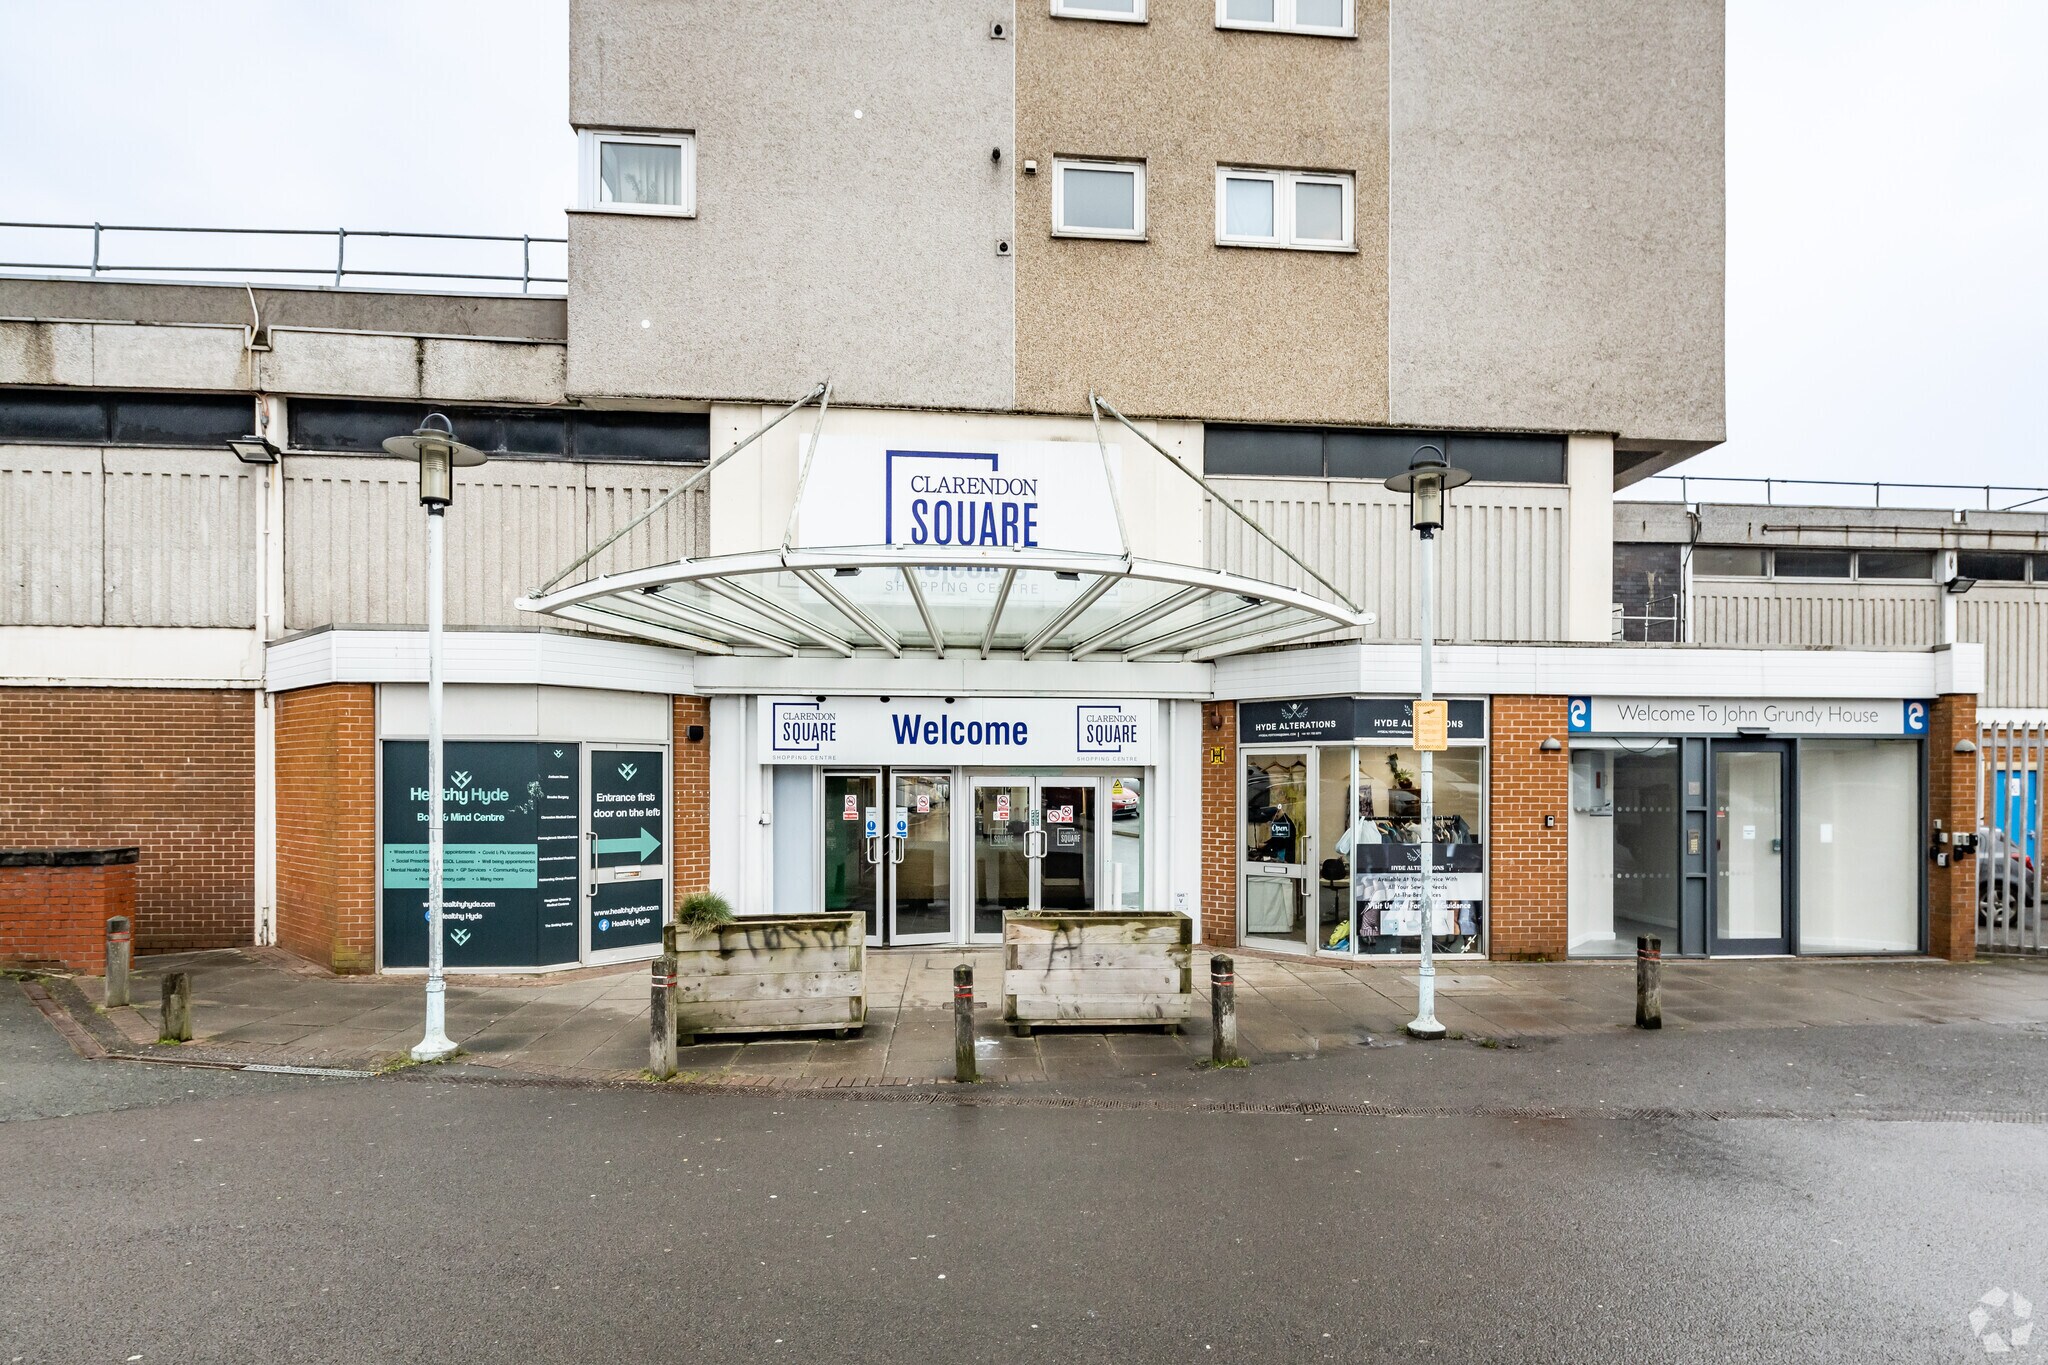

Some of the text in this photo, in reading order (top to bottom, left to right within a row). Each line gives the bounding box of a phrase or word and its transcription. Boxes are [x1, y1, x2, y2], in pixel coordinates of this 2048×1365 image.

[911, 475, 1038, 496] CLARENDON
[911, 499, 1038, 547] SQUARE
[885, 581, 1039, 594] SHPPING CETRE
[1086, 715, 1137, 723] CLARENDON
[1617, 704, 1879, 726] Welcome To John Grundy House
[1256, 720, 1336, 731] HYDE ALTERATIONS
[1374, 719, 1398, 727] HYDE
[783, 722, 836, 744] SQUARE
[892, 714, 1028, 745] Welcome
[1087, 725, 1137, 746] SQUARE
[410, 788, 509, 805] Hethy Hyde
[596, 792, 656, 802] Entrance first
[451, 813, 472, 821] Mind
[473, 813, 505, 822] Centre
[593, 809, 614, 818] door
[629, 808, 644, 817] the
[645, 808, 660, 817] left
[1271, 824, 1288, 834] Open
[593, 905, 659, 916] www.healthyhyde.com
[466, 913, 483, 921] Hyde
[611, 917, 651, 928] Healthy Hyde
